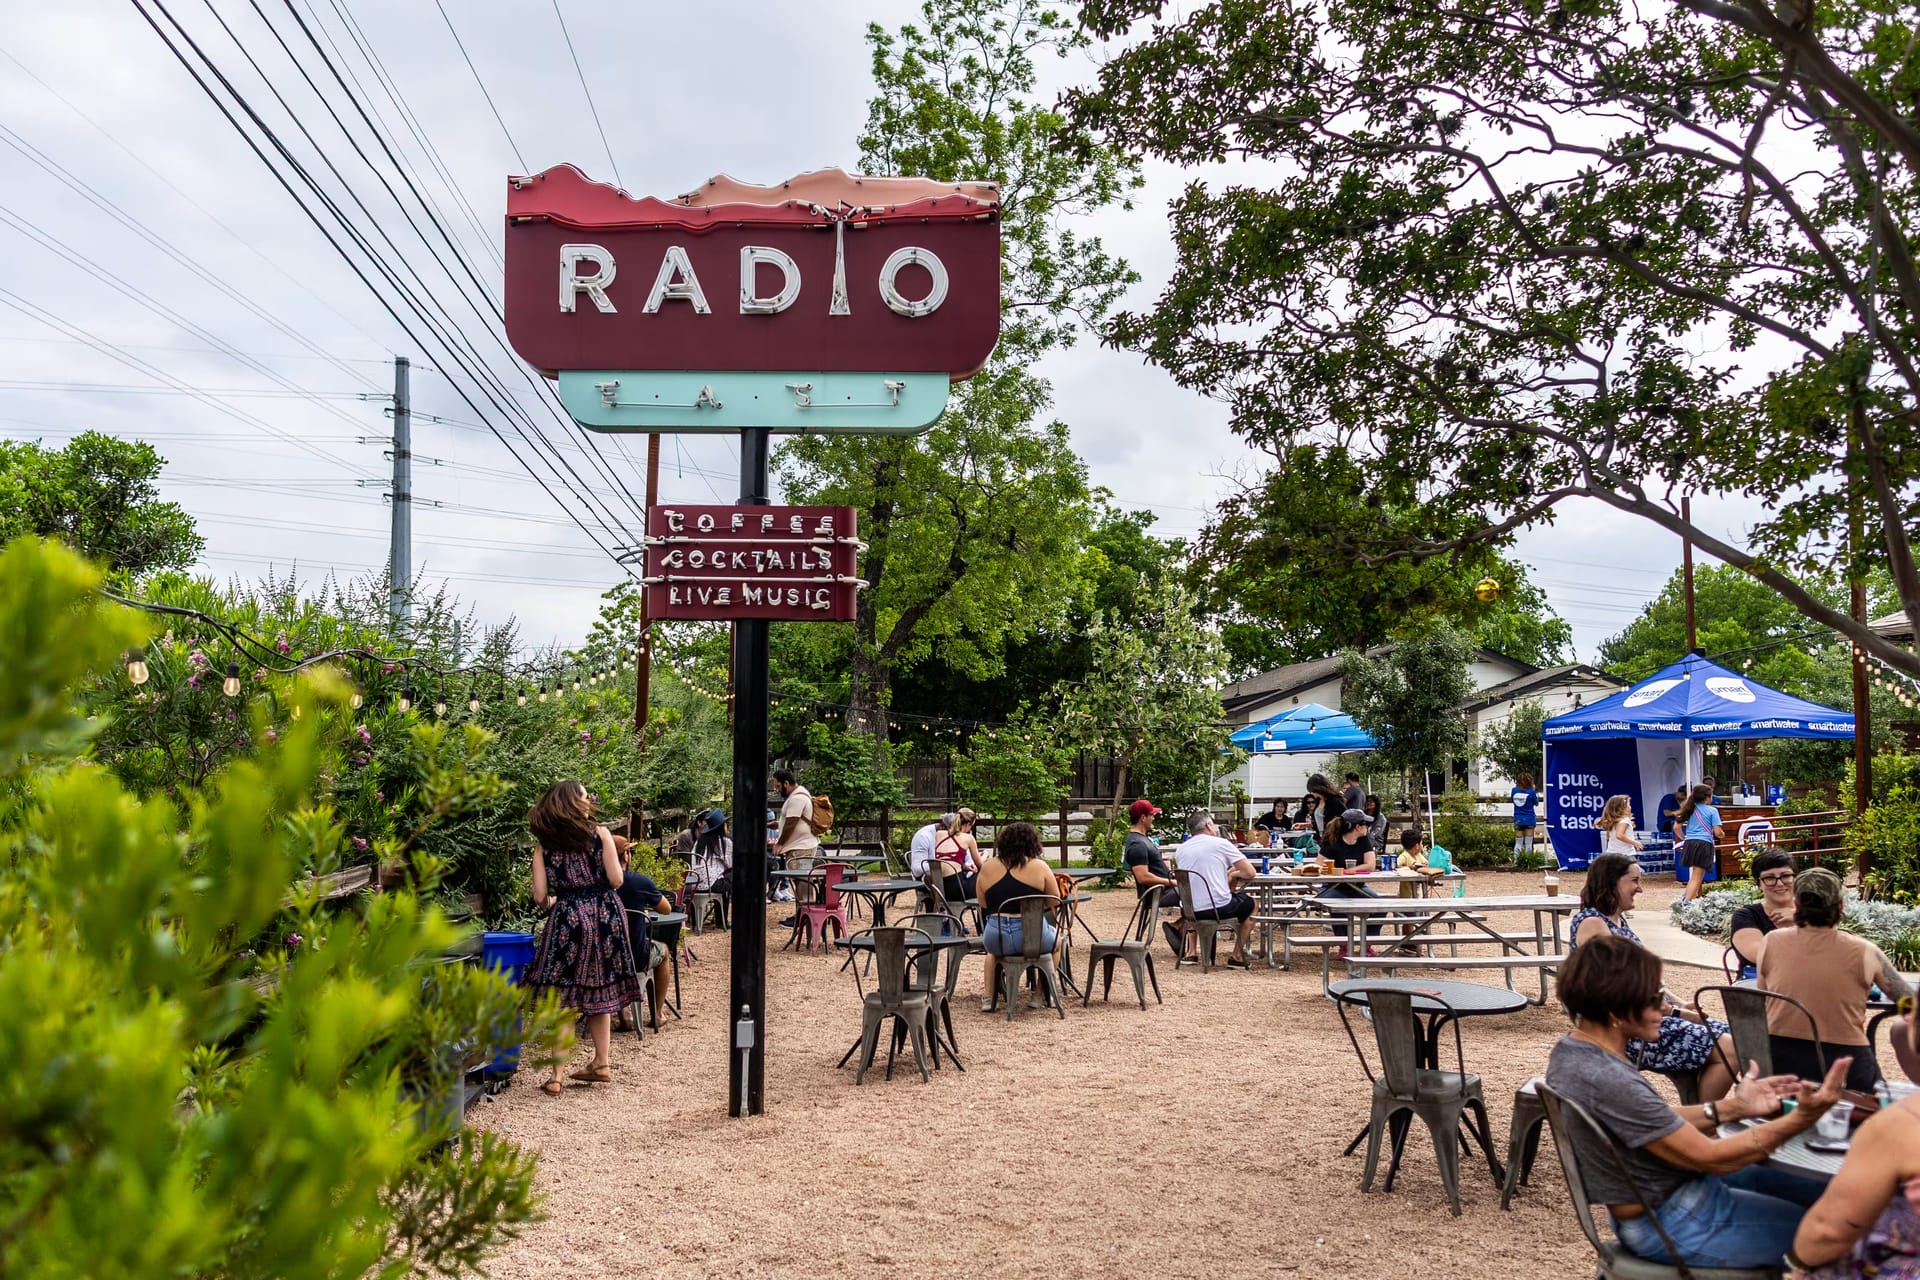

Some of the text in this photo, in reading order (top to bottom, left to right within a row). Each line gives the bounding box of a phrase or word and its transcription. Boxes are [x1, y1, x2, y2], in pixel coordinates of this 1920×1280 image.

[558, 221, 950, 317] RADIO
[595, 379, 907, 410] EAST
[667, 512, 834, 535] COFFEE
[667, 549, 832, 572] COCKTAILS
[669, 586, 831, 609] LIVE MUSIC
[1545, 721, 1683, 735] smartwater smartwater smartwater
[1690, 721, 1742, 733] smartwater
[1750, 718, 1800, 729] smartwater
[1558, 773, 1604, 790] pure,
[1559, 790, 1605, 812] crisp
